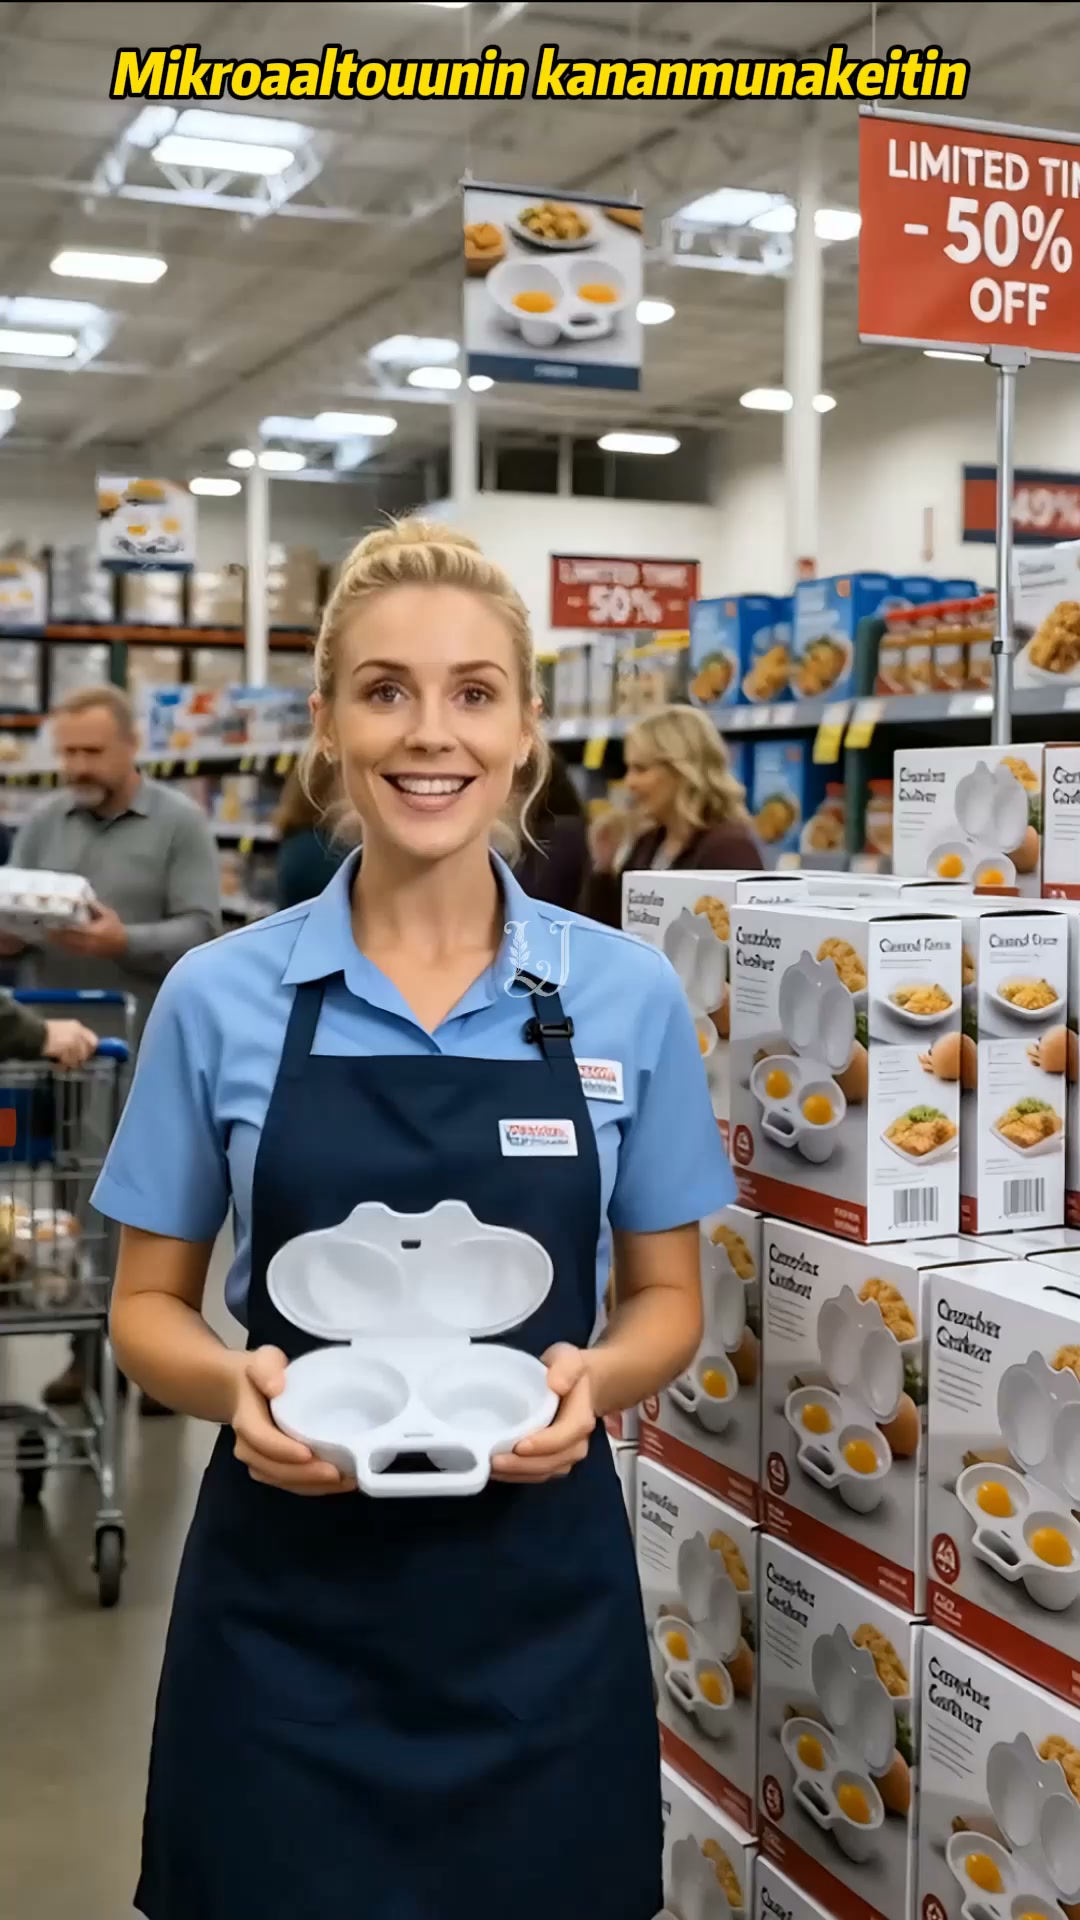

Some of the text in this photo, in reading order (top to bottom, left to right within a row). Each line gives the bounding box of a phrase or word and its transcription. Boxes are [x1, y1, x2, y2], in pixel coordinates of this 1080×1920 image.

[888, 138, 1080, 199] LIMITED TI
[943, 196, 1073, 274] 50%
[969, 276, 1050, 326] OFF
